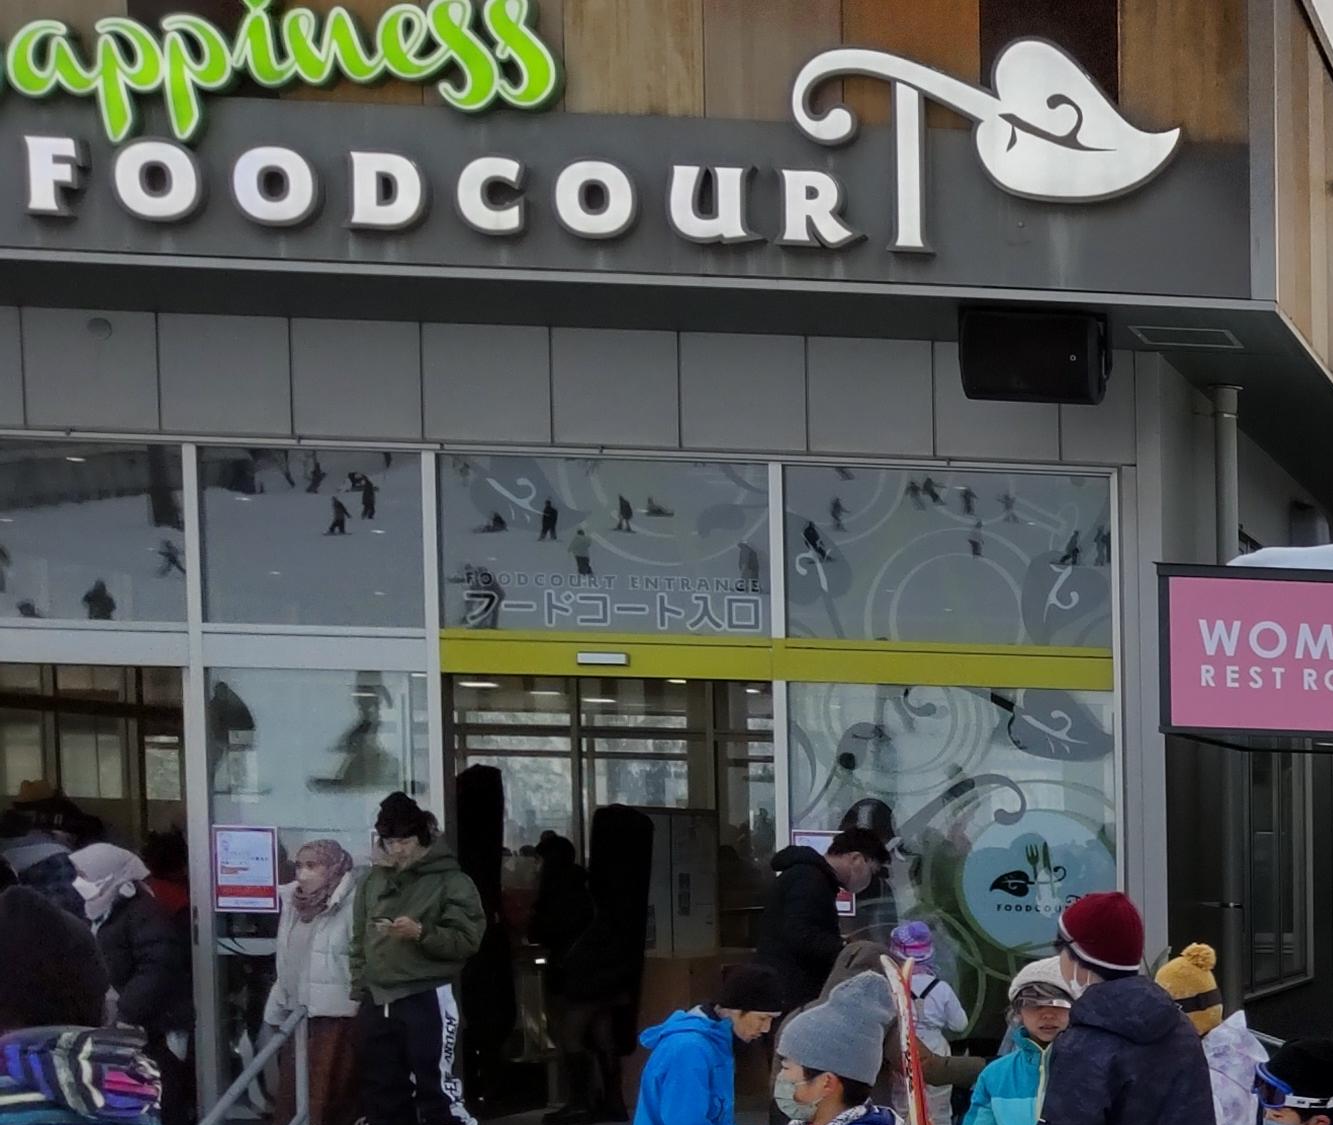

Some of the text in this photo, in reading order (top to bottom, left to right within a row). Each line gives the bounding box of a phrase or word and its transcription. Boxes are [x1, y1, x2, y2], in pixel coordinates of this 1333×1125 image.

[22, 62, 932, 252] FOODCOURT
[465, 572, 761, 594] FOODCOURT ENTRANCE
[463, 590, 763, 632] フードコート入口
[1200, 665, 1284, 691] REST
